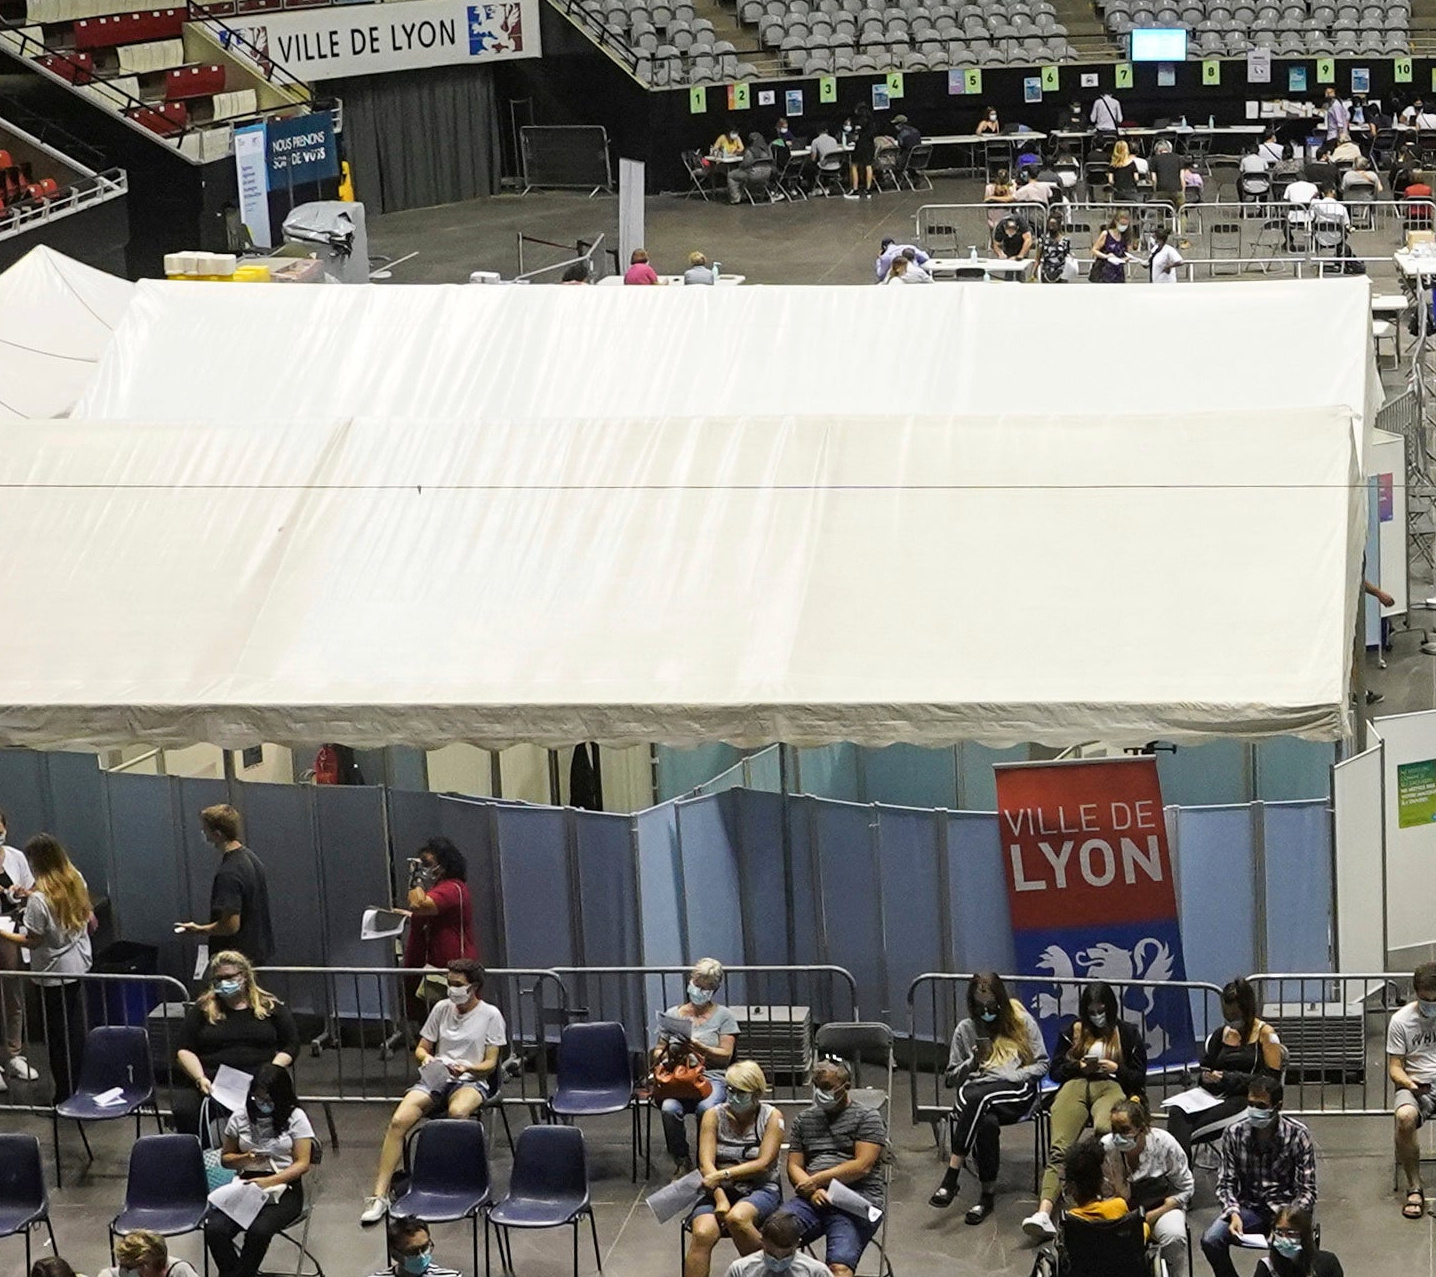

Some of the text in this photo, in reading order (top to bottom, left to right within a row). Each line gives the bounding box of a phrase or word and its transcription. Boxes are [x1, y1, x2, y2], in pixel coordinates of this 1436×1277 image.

[278, 18, 456, 64] VILLE DE LYON
[1208, 67, 1215, 77] 8
[1322, 64, 1329, 74] 9
[1397, 64, 1410, 74] 10
[969, 76, 977, 86] 5
[1047, 72, 1054, 83] 6
[1120, 70, 1128, 81] 7
[825, 84, 832, 94] 3
[892, 79, 899, 89] 4
[695, 93, 701, 104] 1
[738, 90, 746, 101] 2
[272, 137, 292, 153] NOUS
[1004, 800, 1156, 837] VILLE DE
[1010, 835, 1163, 892] LYON
